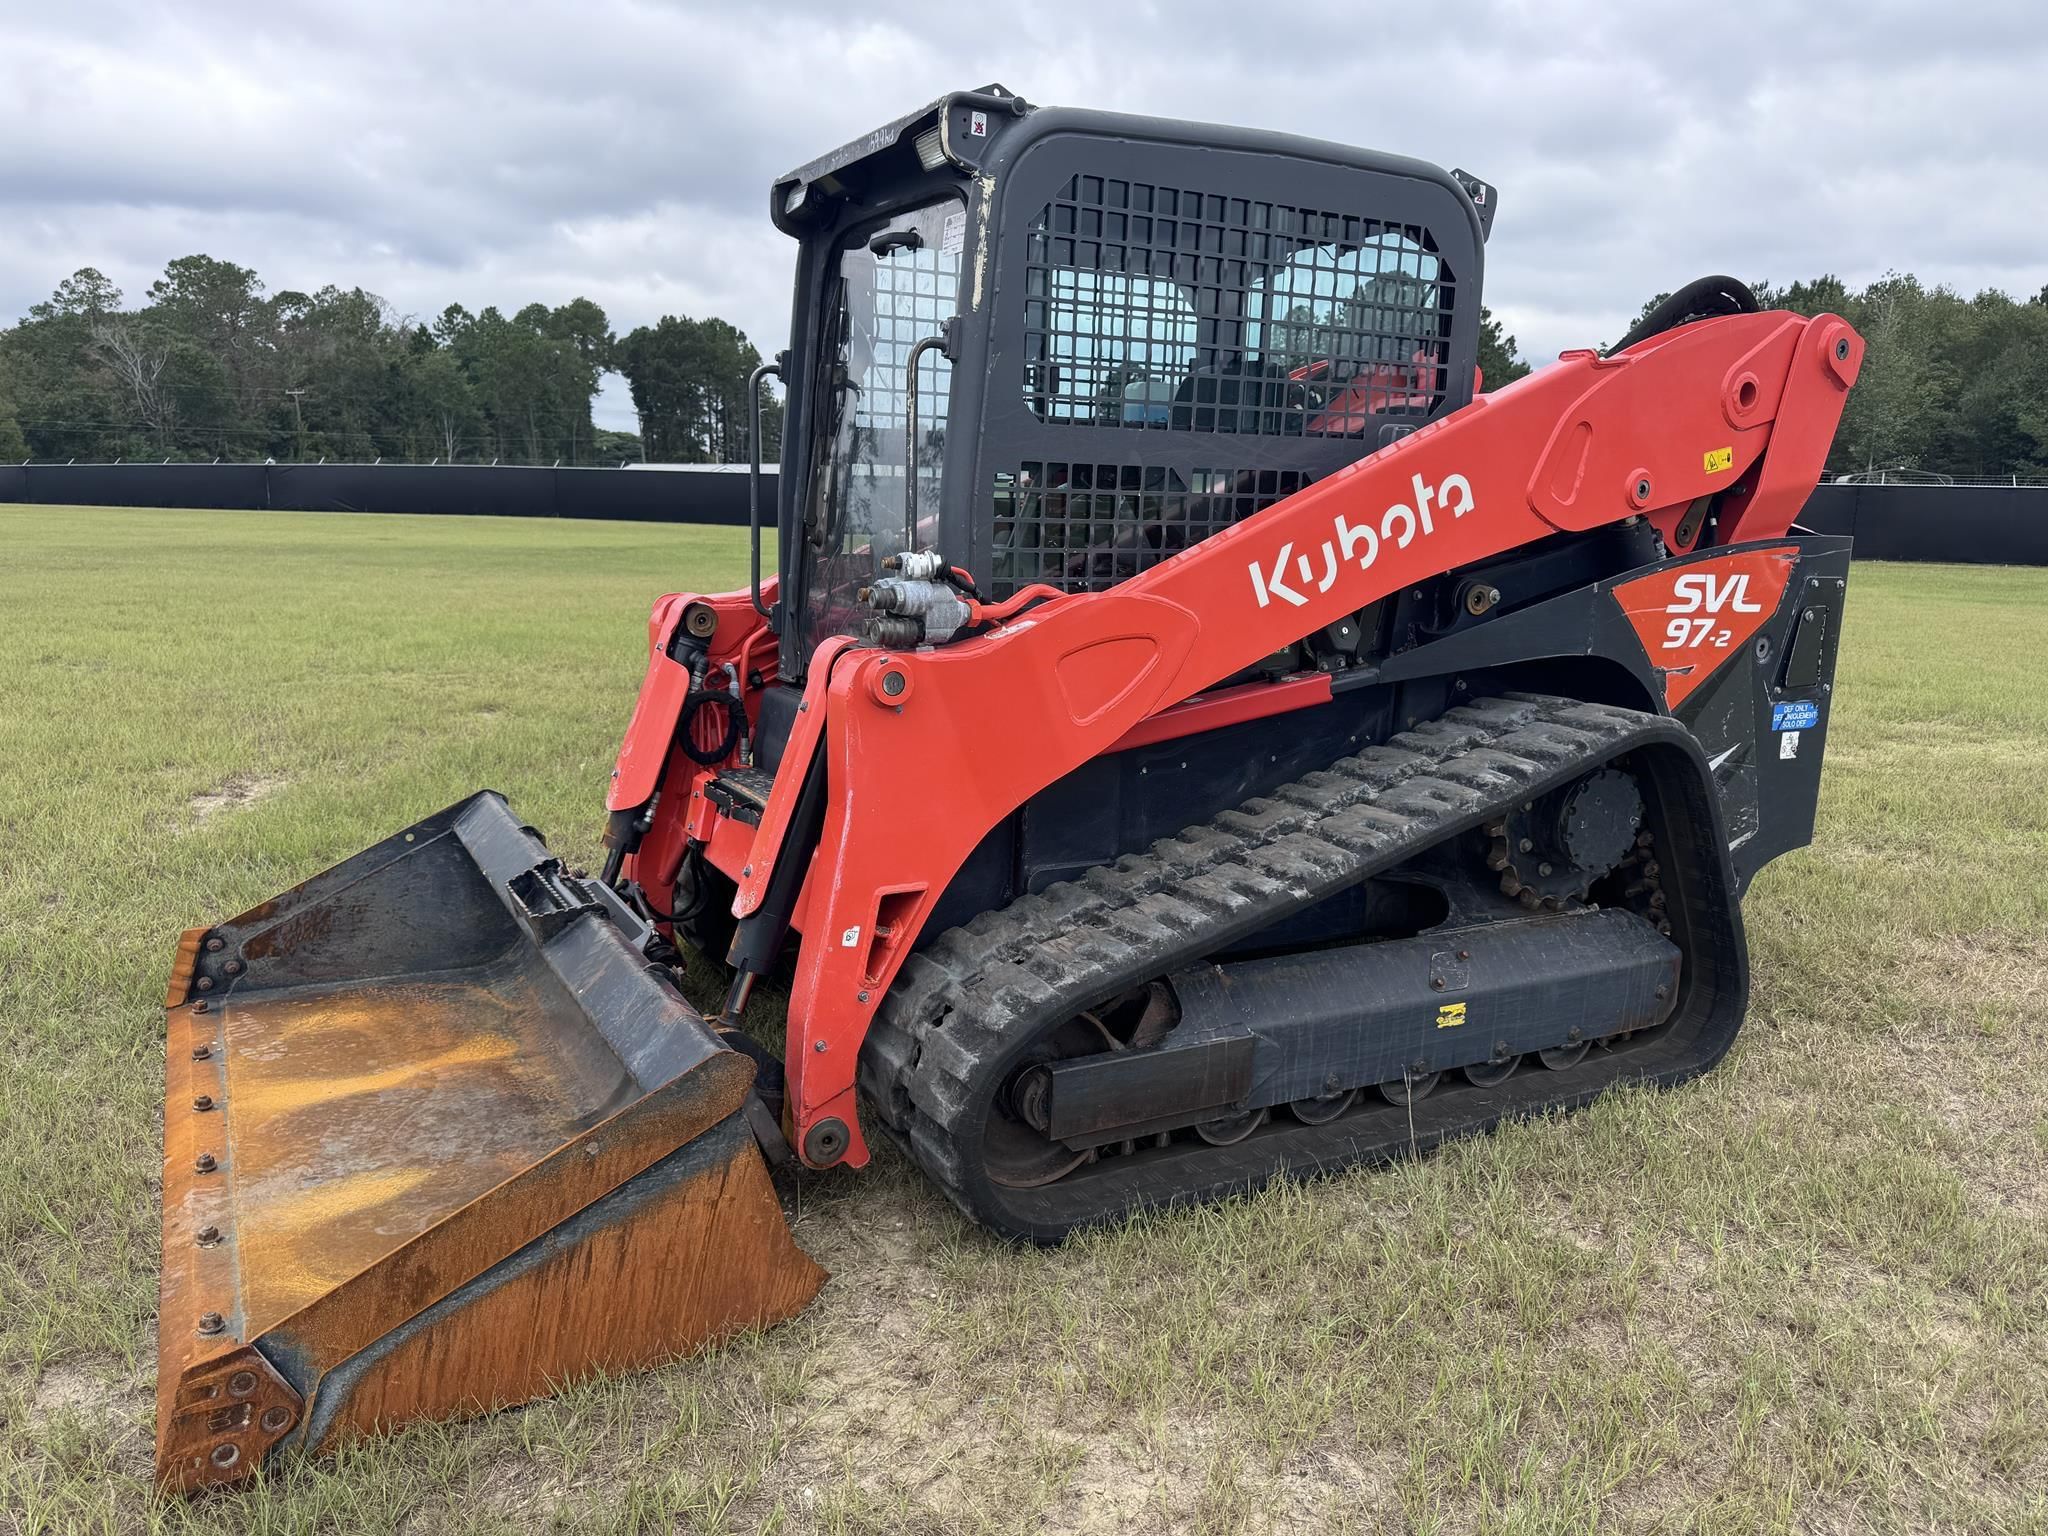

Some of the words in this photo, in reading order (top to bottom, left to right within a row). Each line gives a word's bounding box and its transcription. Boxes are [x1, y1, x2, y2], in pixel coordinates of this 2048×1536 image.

[1248, 473, 1475, 608] Kubota
[1666, 574, 1761, 613] SVL
[1662, 618, 1732, 648] 97-2
[1773, 713, 1784, 721] DEF
[1783, 705, 1794, 713] DEF
[1795, 704, 1808, 712] ONLY
[1781, 720, 1795, 728] SOLO
[1796, 719, 1807, 728] DEF
